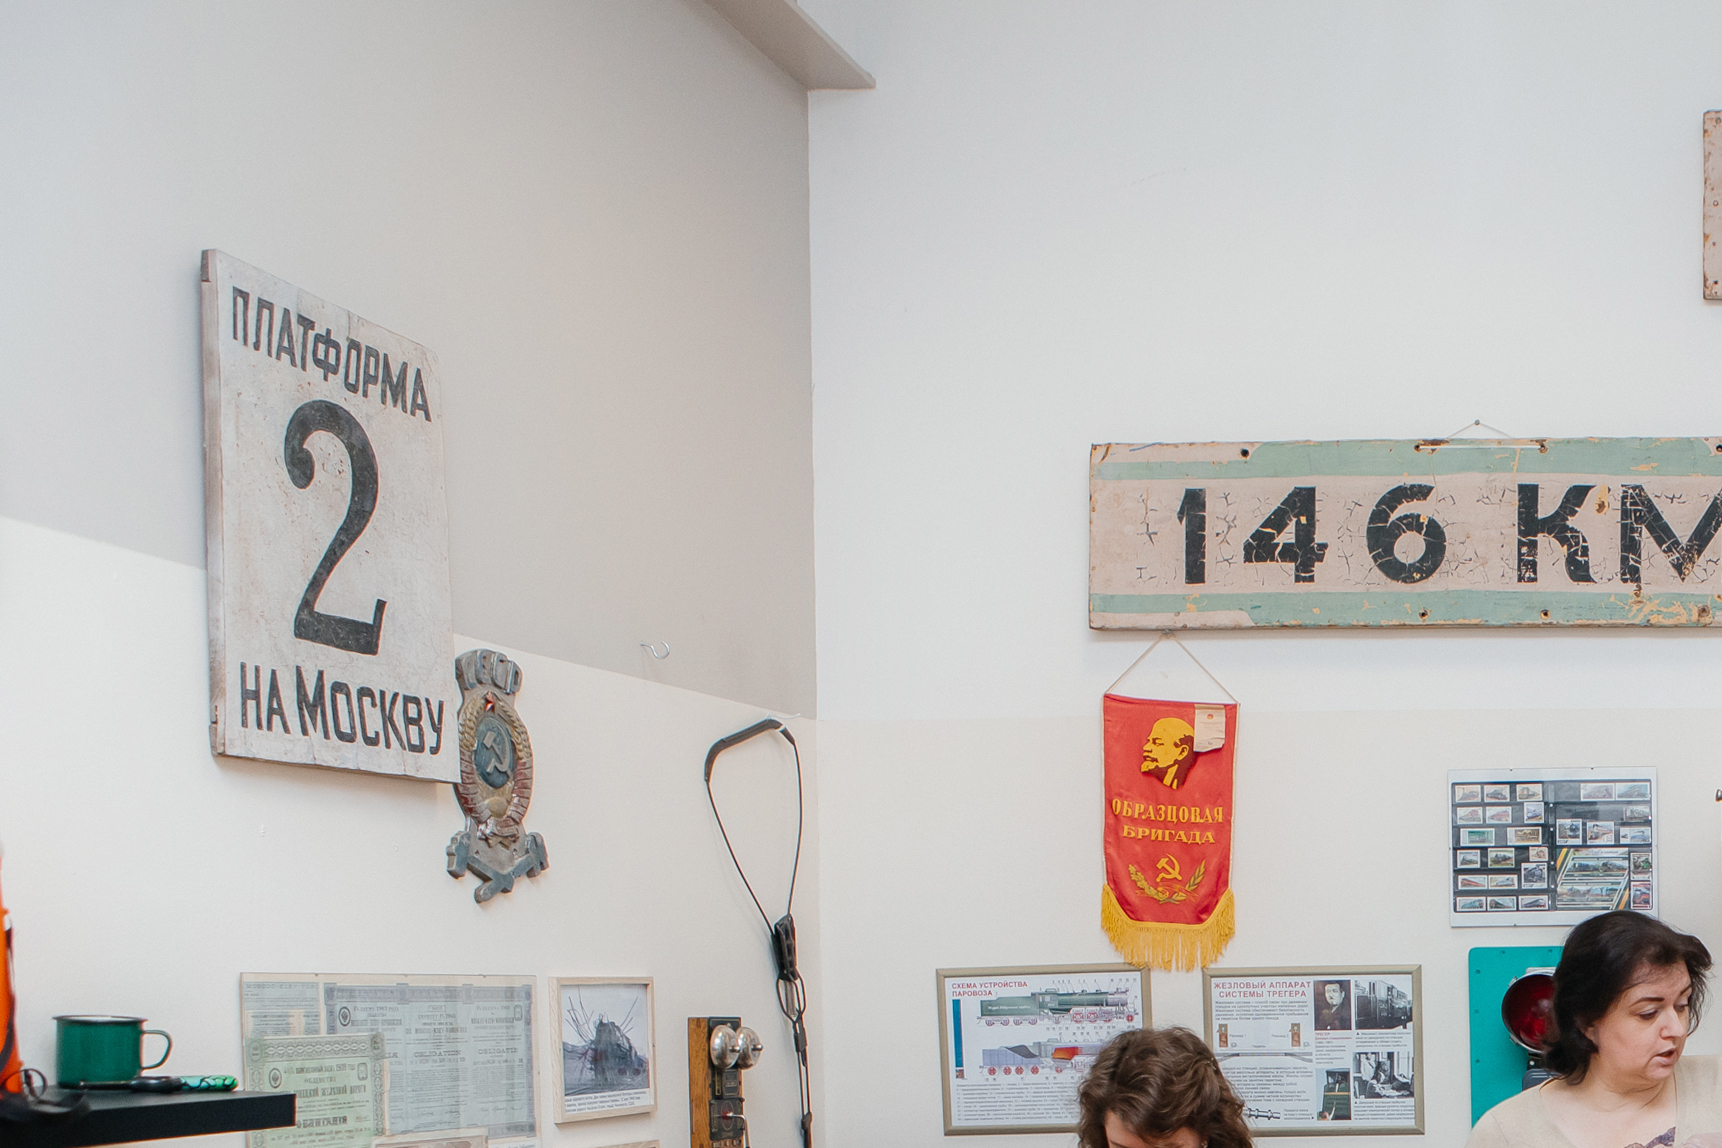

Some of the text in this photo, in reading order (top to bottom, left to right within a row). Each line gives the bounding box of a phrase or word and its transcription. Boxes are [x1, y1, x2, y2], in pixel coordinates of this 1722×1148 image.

[232, 285, 432, 423] ПЛАТФОРМА
[283, 399, 387, 656] 2
[1176, 483, 1446, 585] 146
[240, 661, 444, 755] НА МОСКВУ
[1112, 798, 1223, 824] ОБРАЗЦОВАЯ
[1122, 824, 1215, 845] БРИГАДА
[979, 980, 1028, 989] УСТРОЙСТВА
[1213, 980, 1311, 989] ЖЕЗЛОВЫЙ АППАРАТ
[1219, 990, 1307, 998] СИСТЕМЫ ТРЕГЕРА
